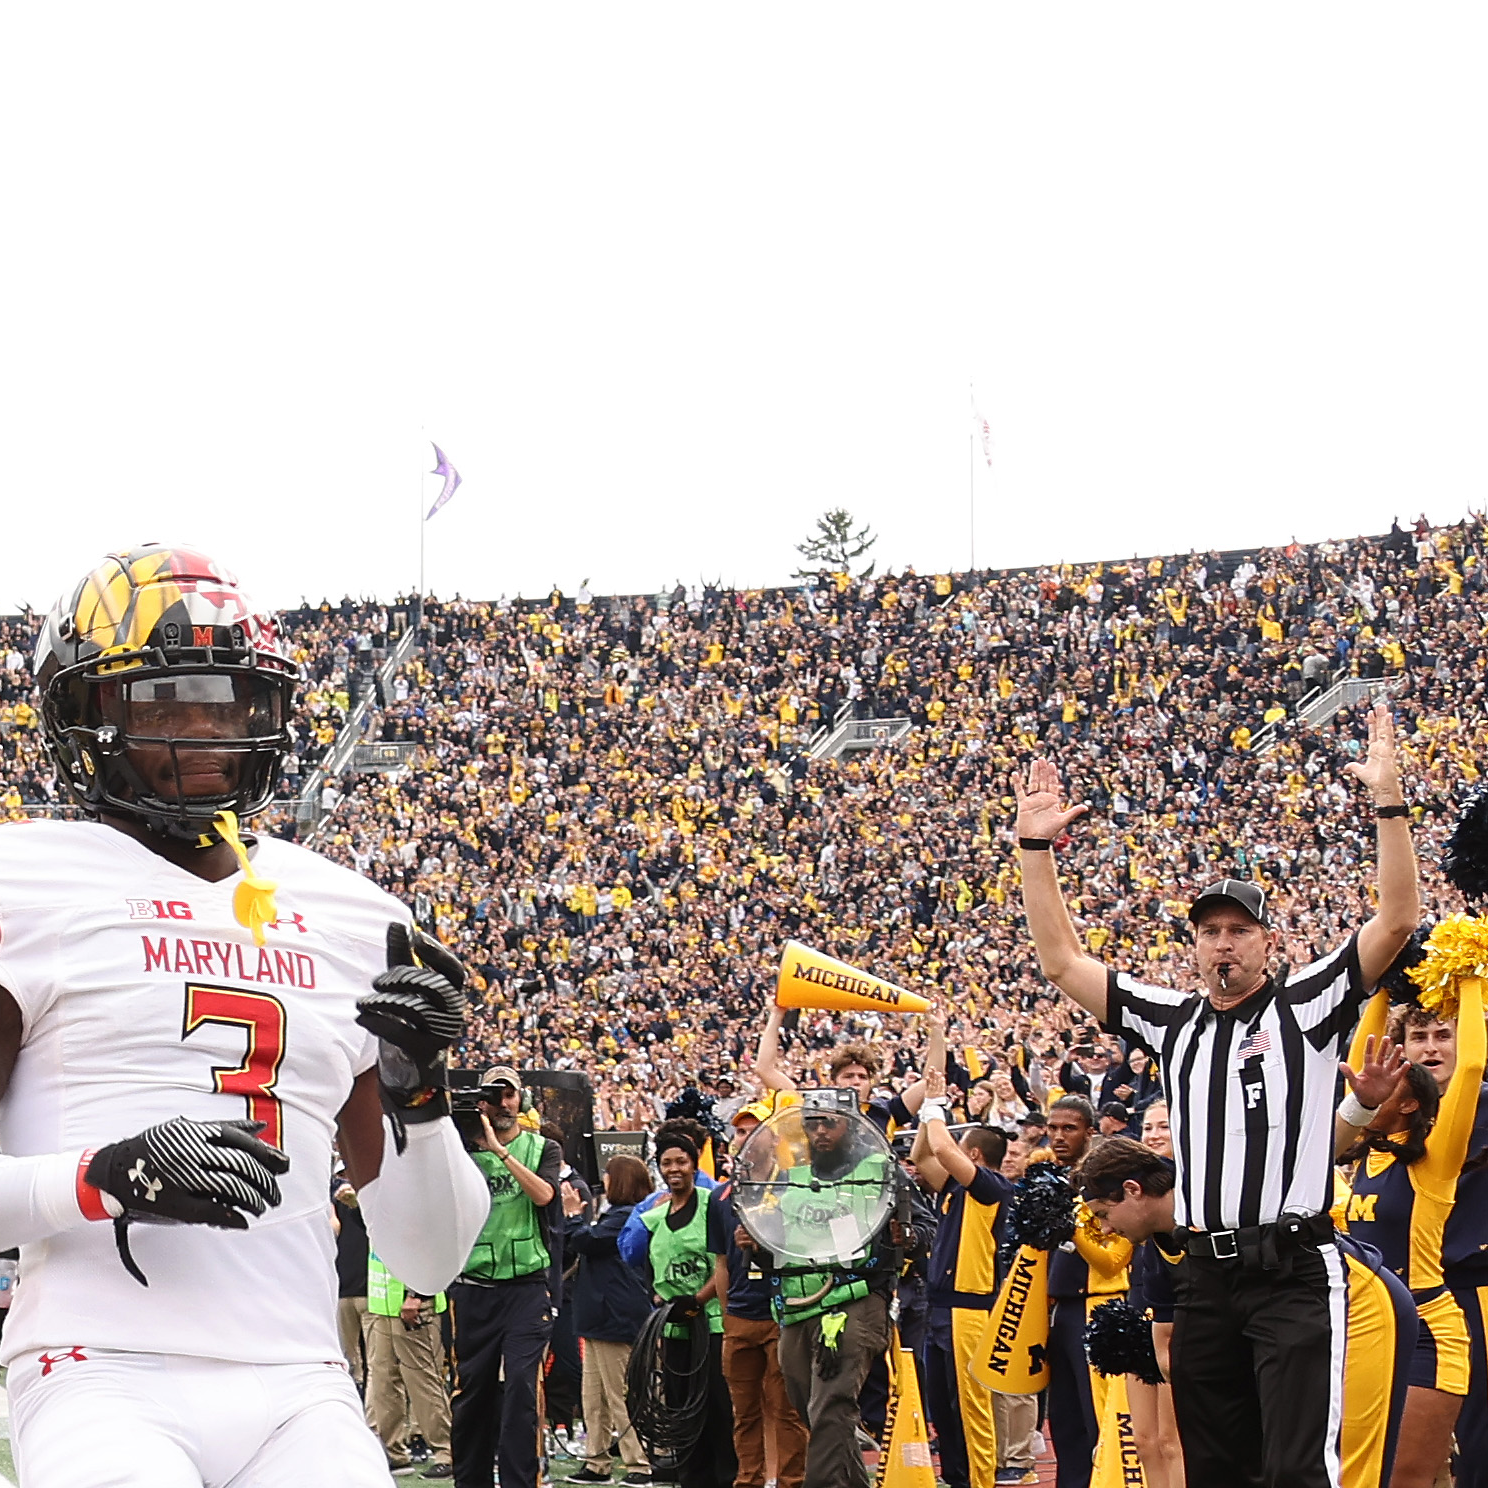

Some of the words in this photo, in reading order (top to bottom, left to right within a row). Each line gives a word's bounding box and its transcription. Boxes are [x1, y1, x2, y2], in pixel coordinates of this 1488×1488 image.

[191, 626, 214, 647] M
[141, 935, 316, 990] MARYLAND
[792, 962, 901, 1005] MICHIGAN
[181, 981, 288, 1155] 3
[1245, 1081, 1263, 1110] F
[1347, 1194, 1379, 1222] M
[987, 1254, 1038, 1376] MICHIGAN
